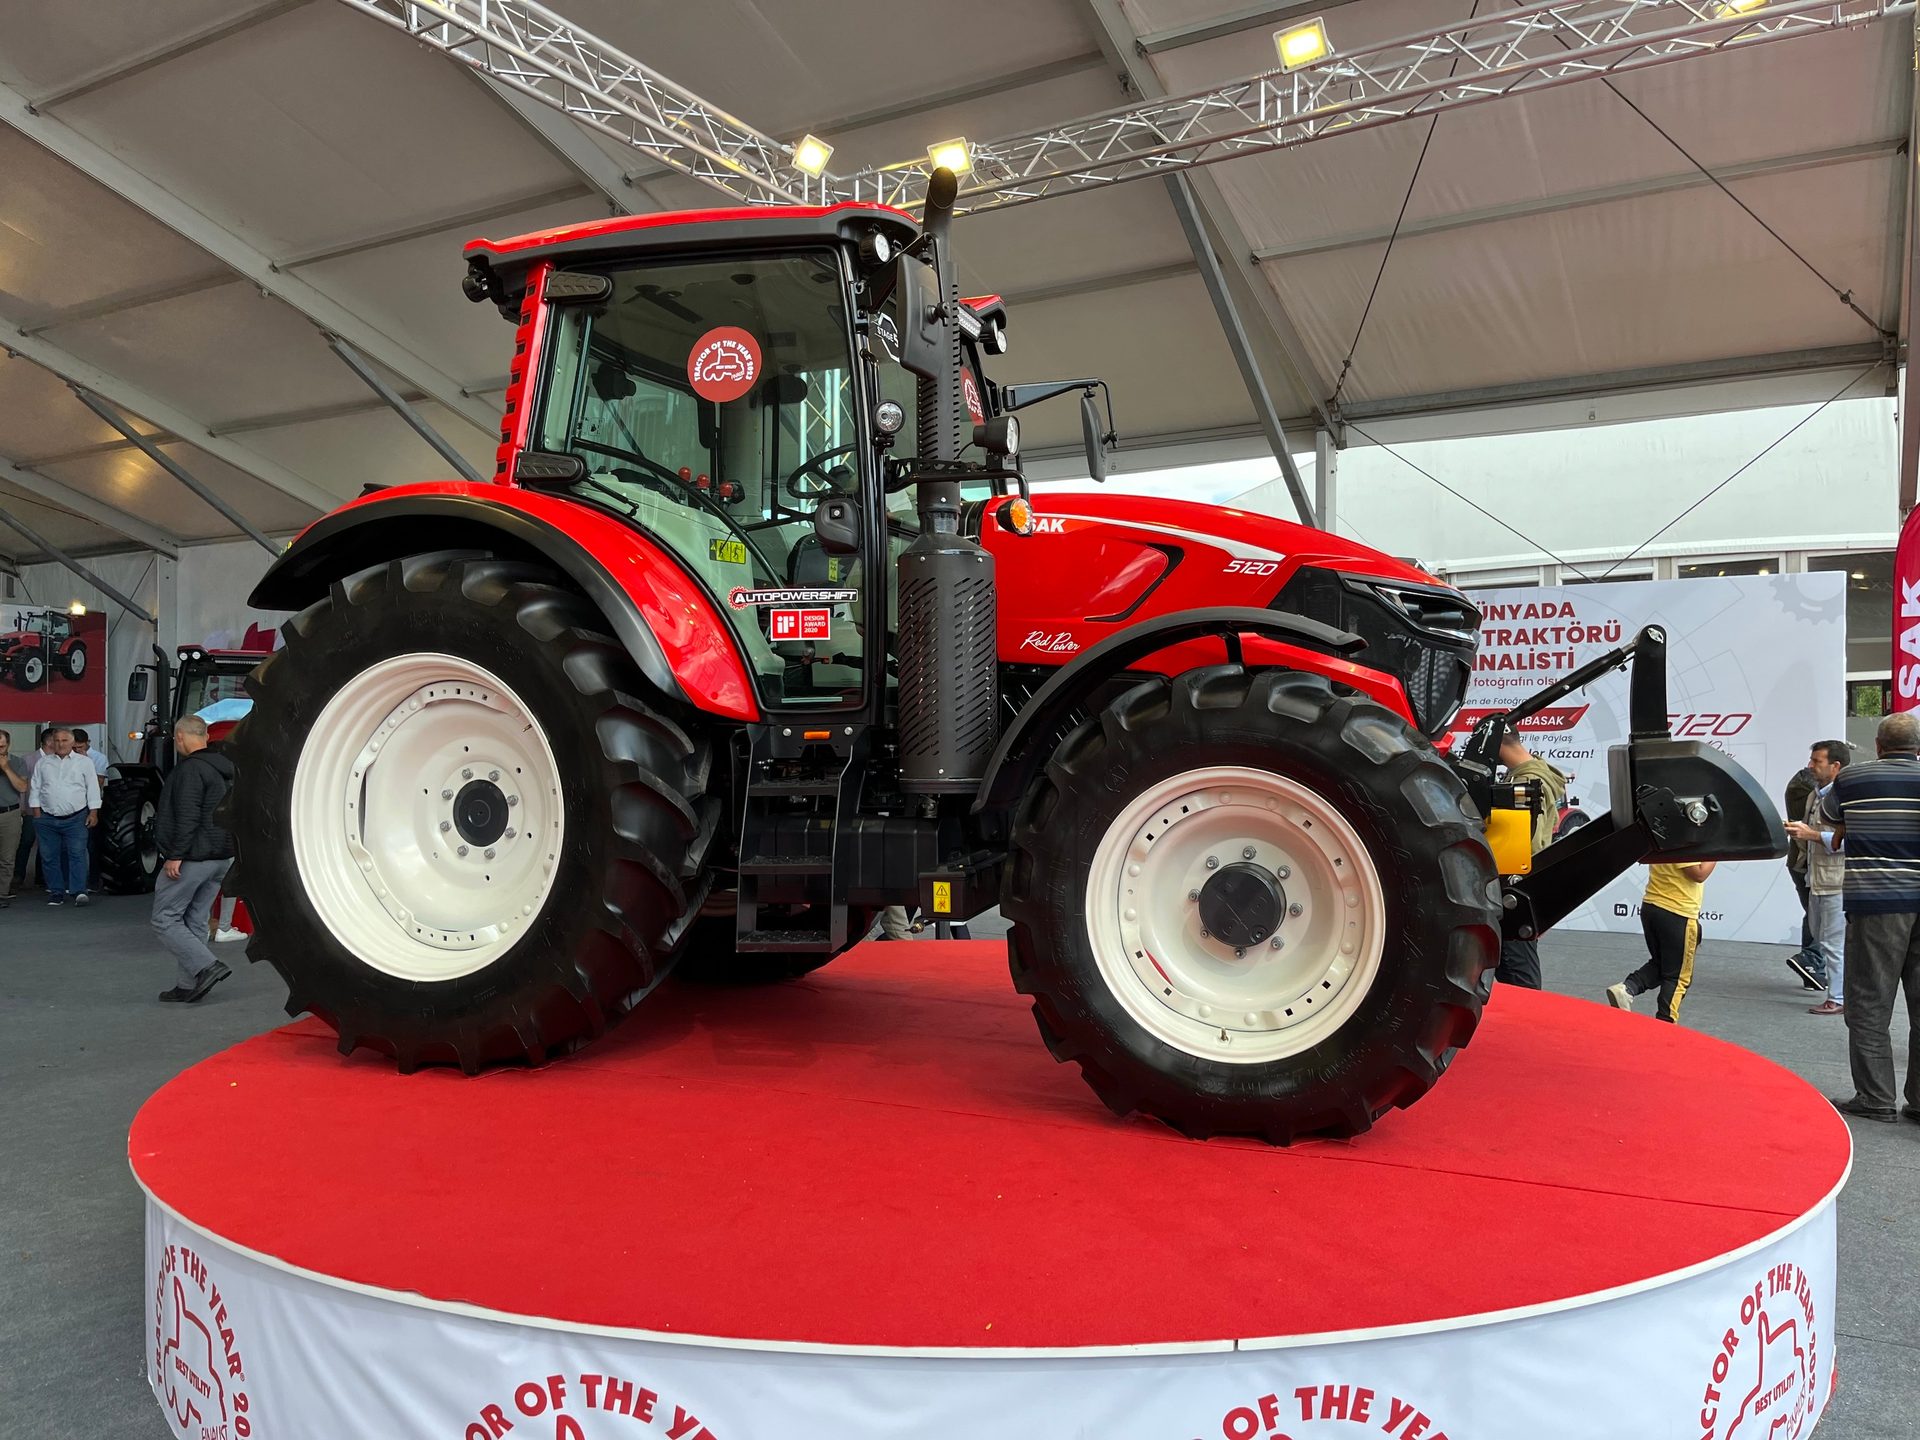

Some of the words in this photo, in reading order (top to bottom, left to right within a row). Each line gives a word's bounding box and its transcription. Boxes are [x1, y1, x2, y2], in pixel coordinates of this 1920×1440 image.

[694, 348, 711, 381] TRACTOR
[711, 341, 721, 350] OF
[723, 340, 737, 348] THE
[737, 343, 752, 360] YEAR
[1223, 560, 1279, 576] 5120
[735, 591, 857, 604] AUTOPOWERSHIFT
[1476, 601, 1576, 621] ÜNYADA
[1020, 631, 1052, 650] Red
[1048, 632, 1080, 652] Power
[1482, 619, 1621, 646] TRAKTÖRÜ
[1474, 677, 1533, 689] fotoğrafın
[1548, 749, 1594, 759] Kazan!
[1741, 1281, 1763, 1325] OF
[1768, 1263, 1793, 1297] THE
[165, 1245, 176, 1272] OF
[181, 1247, 207, 1293] THE
[233, 1392, 251, 1440] 20
[175, 1356, 188, 1379] BEST
[189, 1369, 211, 1399] UTILITY
[1755, 1391, 1772, 1416] BEST
[1772, 1370, 1795, 1403] UTILITY
[514, 1375, 567, 1416] OF
[580, 1374, 658, 1424] THE
[1222, 1393, 1279, 1440] OF
[1294, 1384, 1375, 1424] THE
